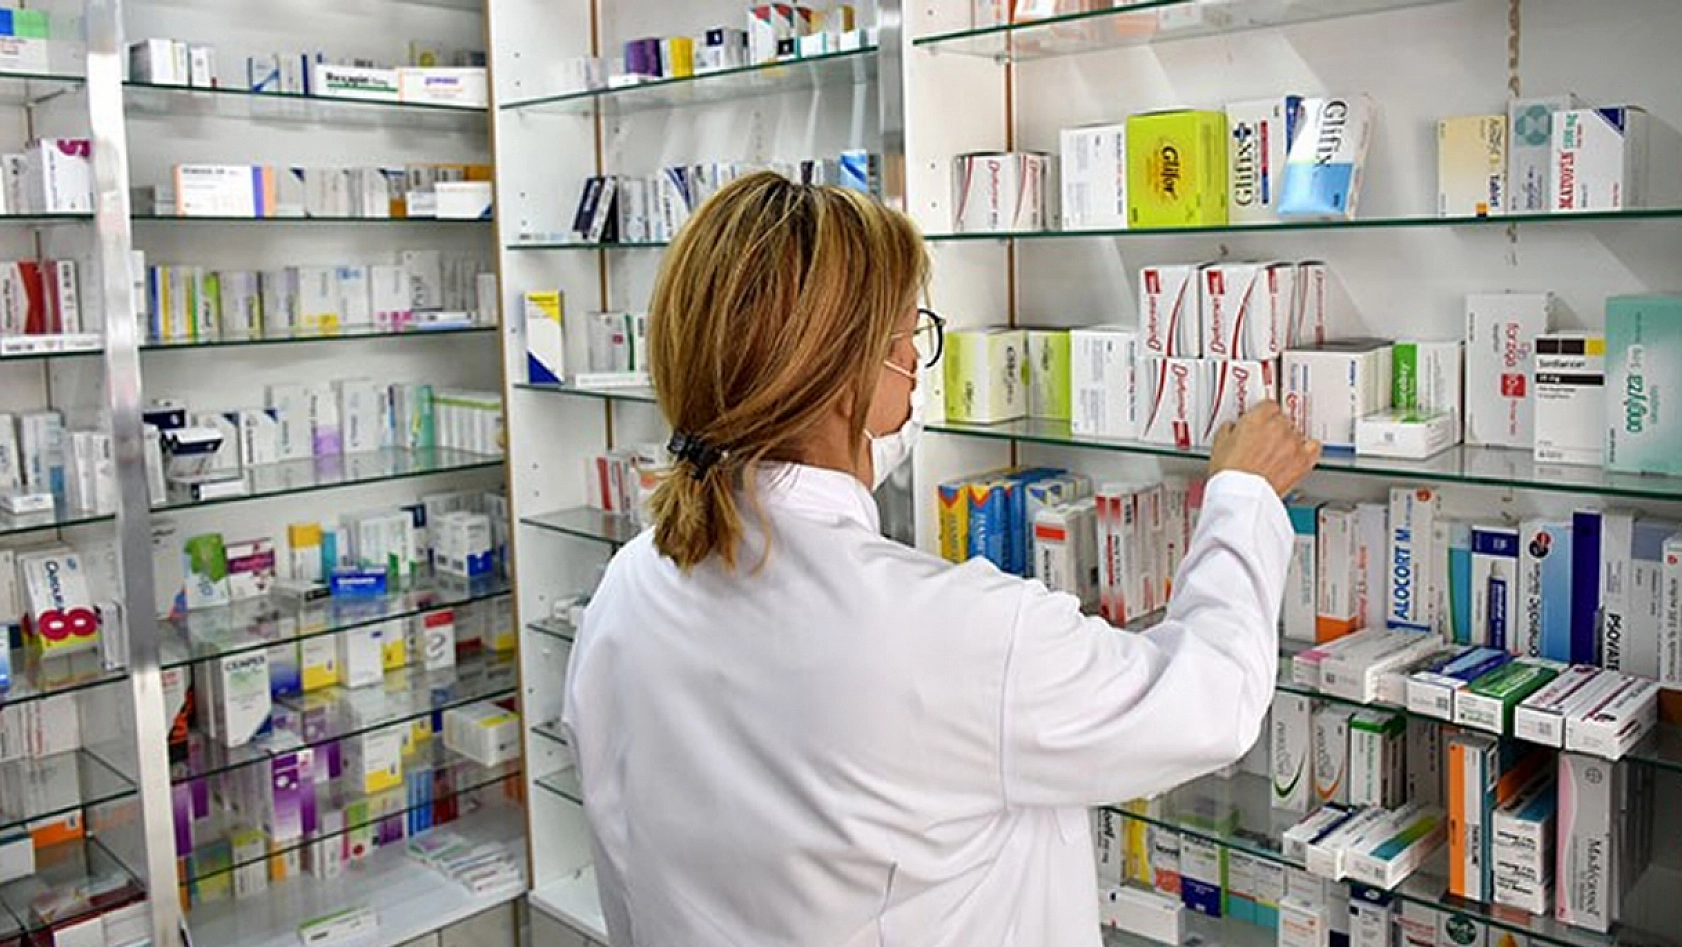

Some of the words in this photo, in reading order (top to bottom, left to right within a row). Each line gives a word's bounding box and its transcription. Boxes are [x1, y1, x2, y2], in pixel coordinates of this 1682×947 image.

[1315, 100, 1348, 167] Glifix
[1234, 142, 1254, 206] Glifix
[1625, 375, 1646, 432] onglyza
[1394, 527, 1412, 544] M
[1393, 546, 1412, 620] ALOCORT
[38, 608, 97, 641] 8
